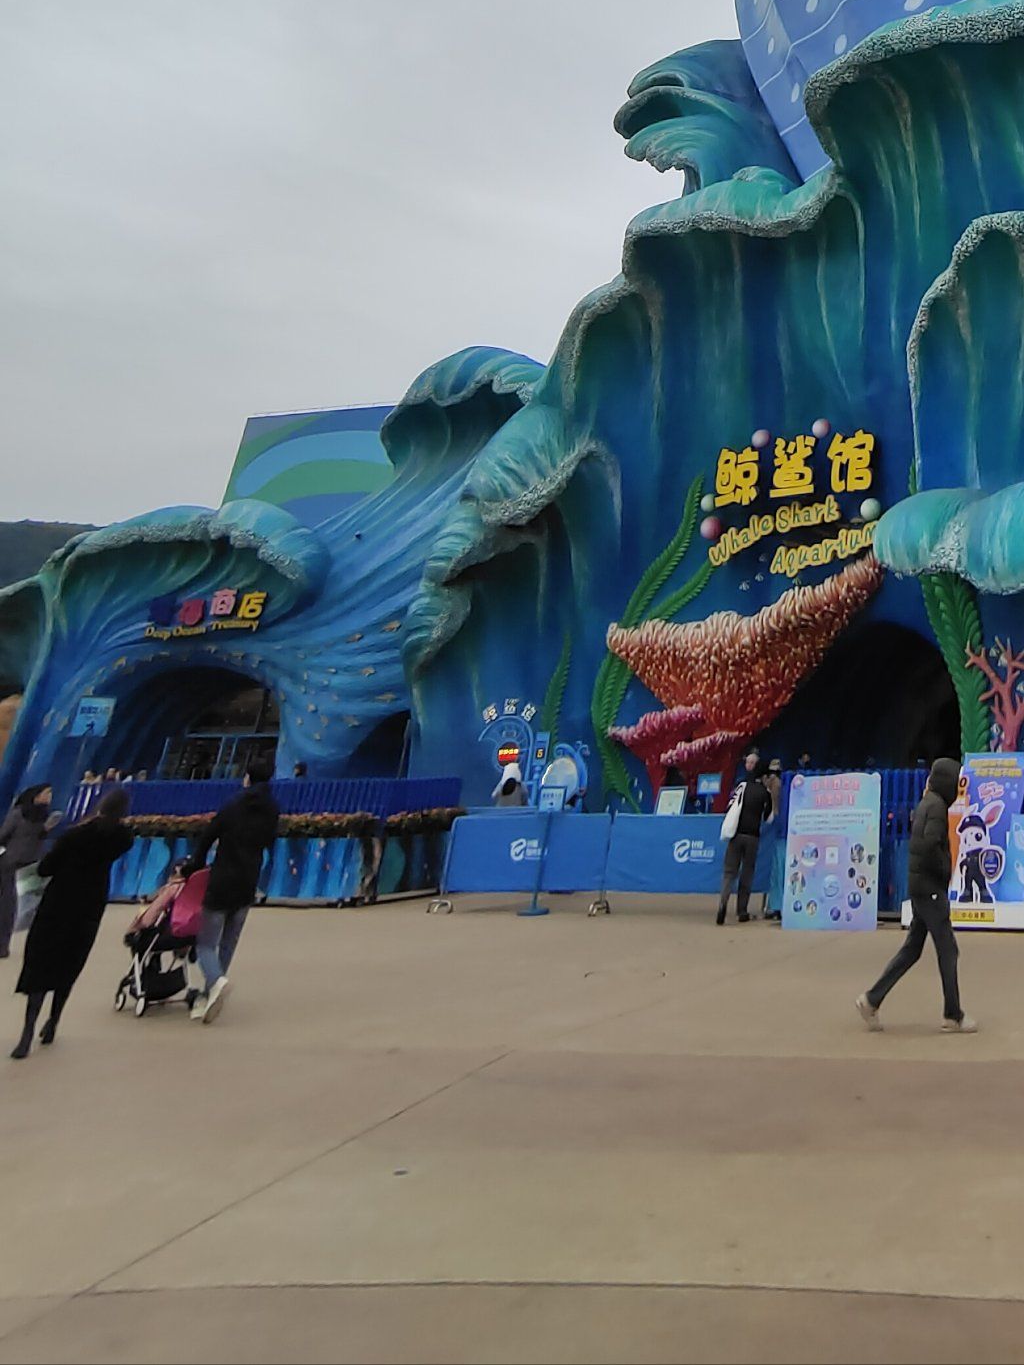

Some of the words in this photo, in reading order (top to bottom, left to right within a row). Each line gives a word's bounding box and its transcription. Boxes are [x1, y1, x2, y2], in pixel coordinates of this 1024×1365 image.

[714, 429, 875, 507] 鲸鲨馆
[708, 514, 774, 566] Whale
[775, 494, 842, 533] Shark
